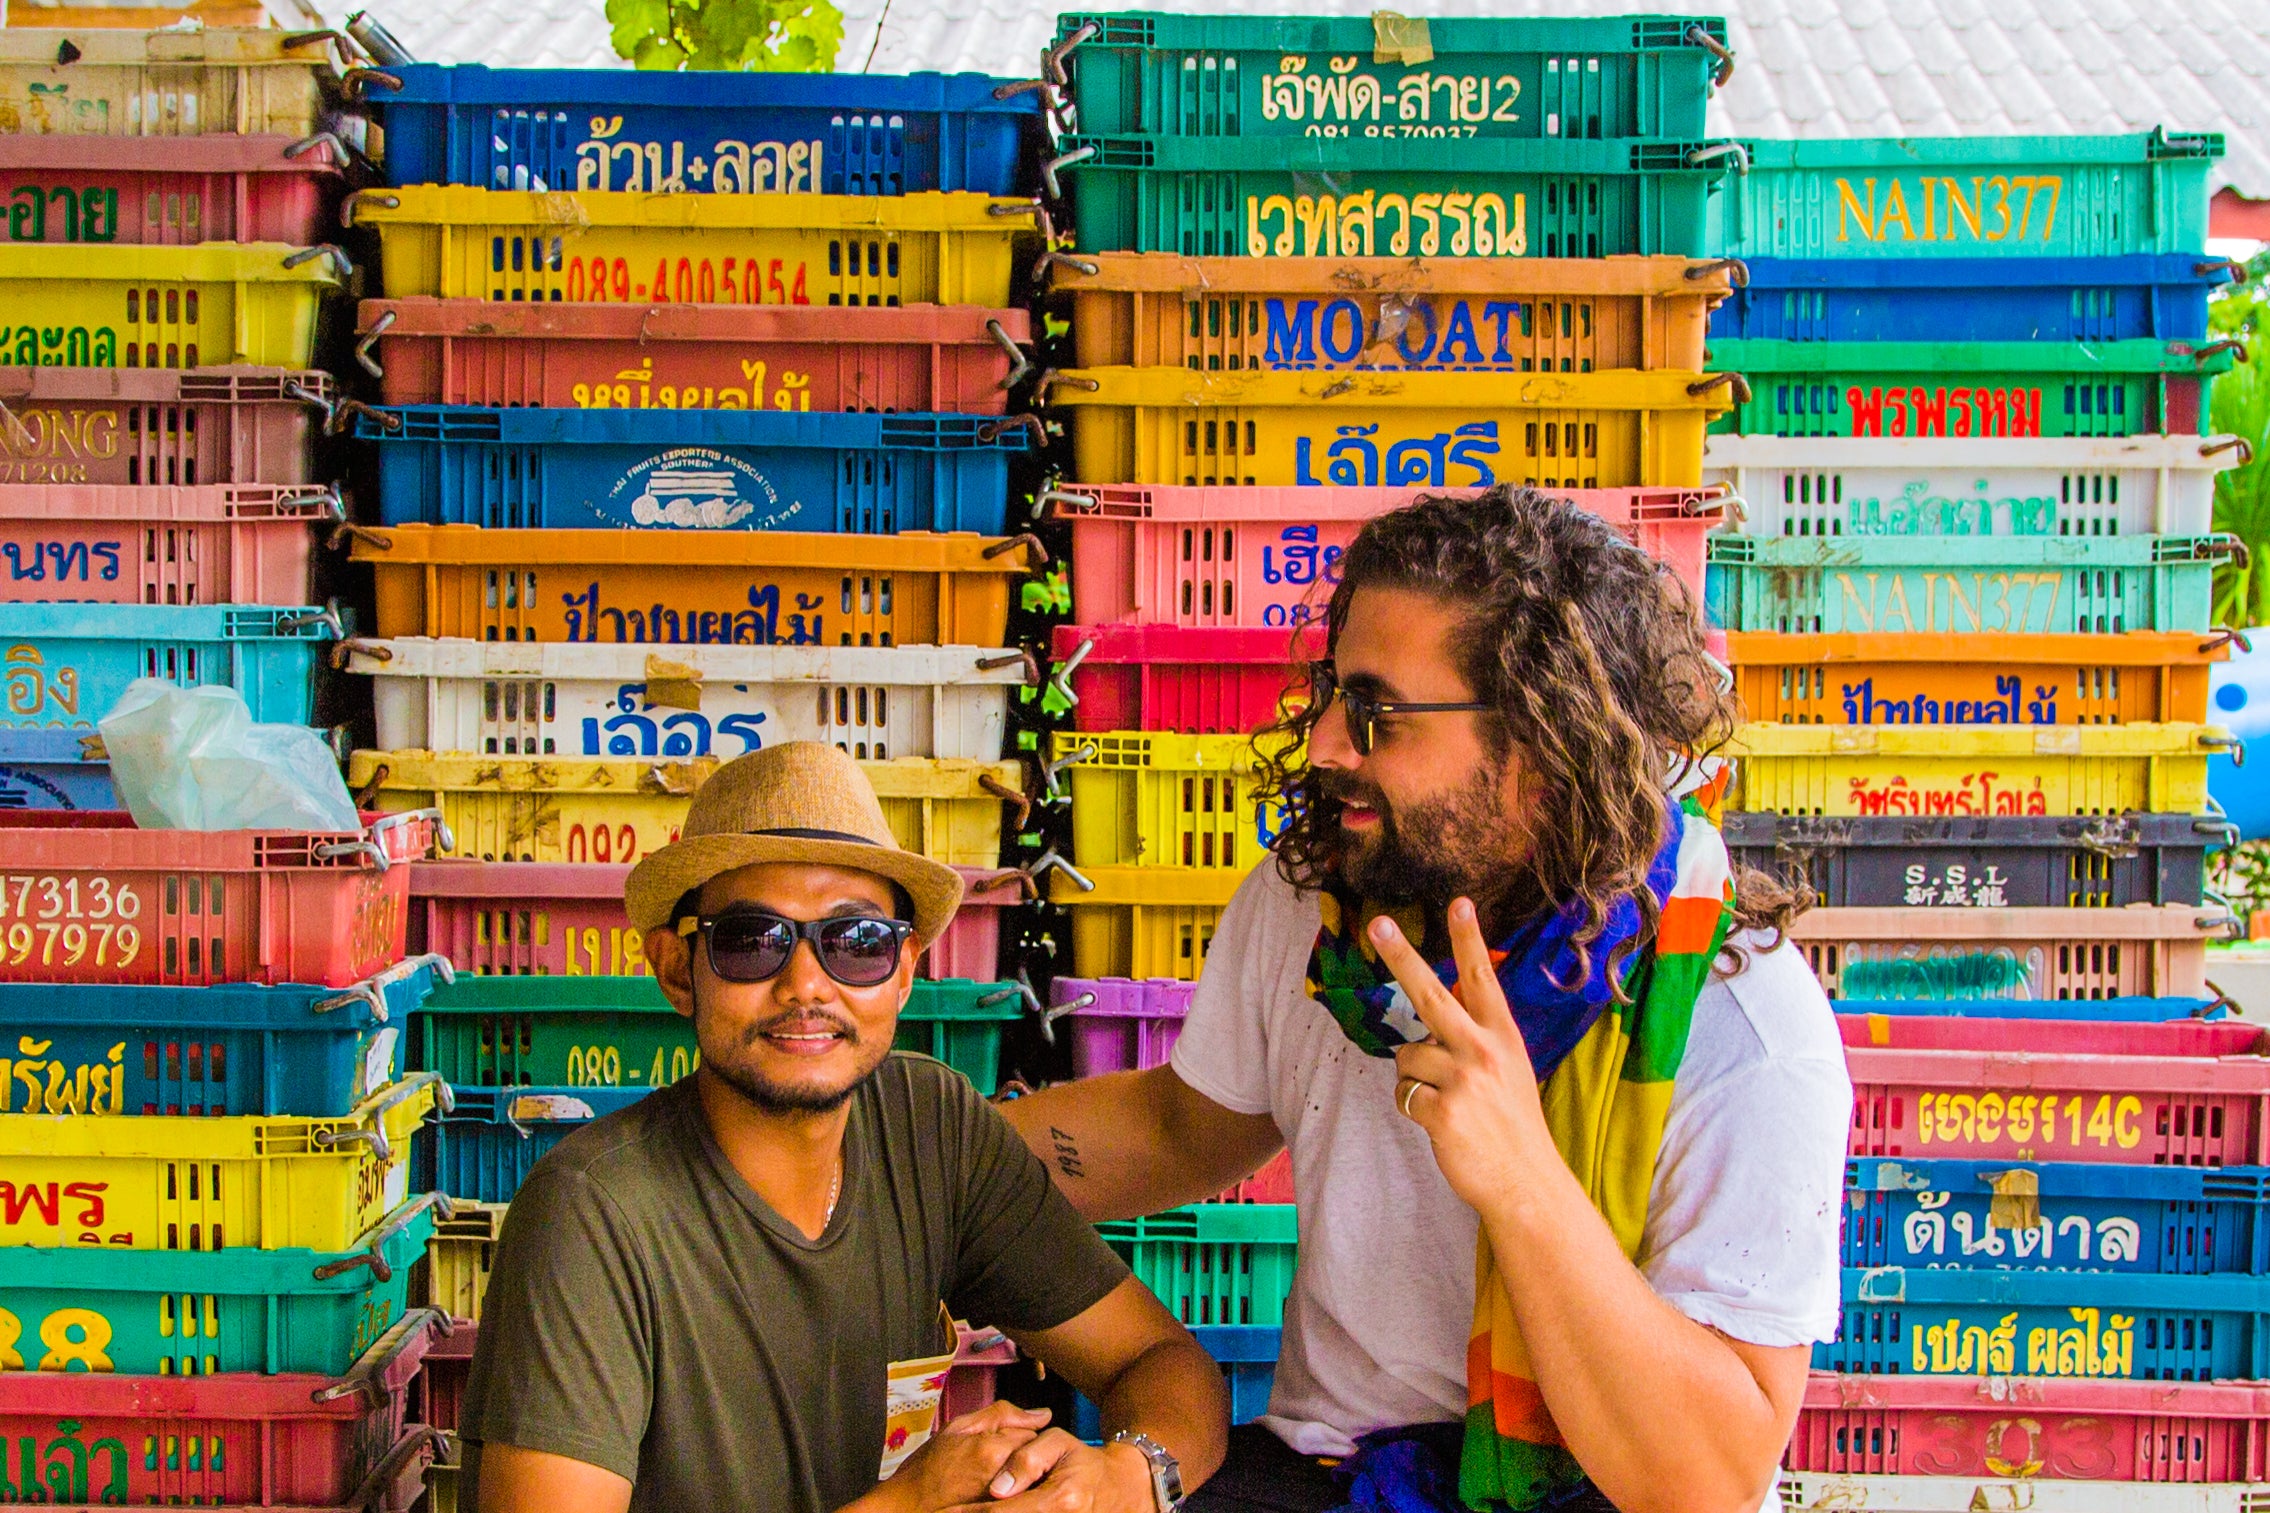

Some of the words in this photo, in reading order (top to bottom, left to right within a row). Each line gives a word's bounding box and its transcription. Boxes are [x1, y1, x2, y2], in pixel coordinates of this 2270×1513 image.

[1835, 175, 2063, 242] NAIN377
[626, 455, 661, 479] FRUITS
[1835, 573, 2063, 633] NAIN377
[0, 922, 141, 968] 97979
[2063, 1094, 2143, 1149] 14C
